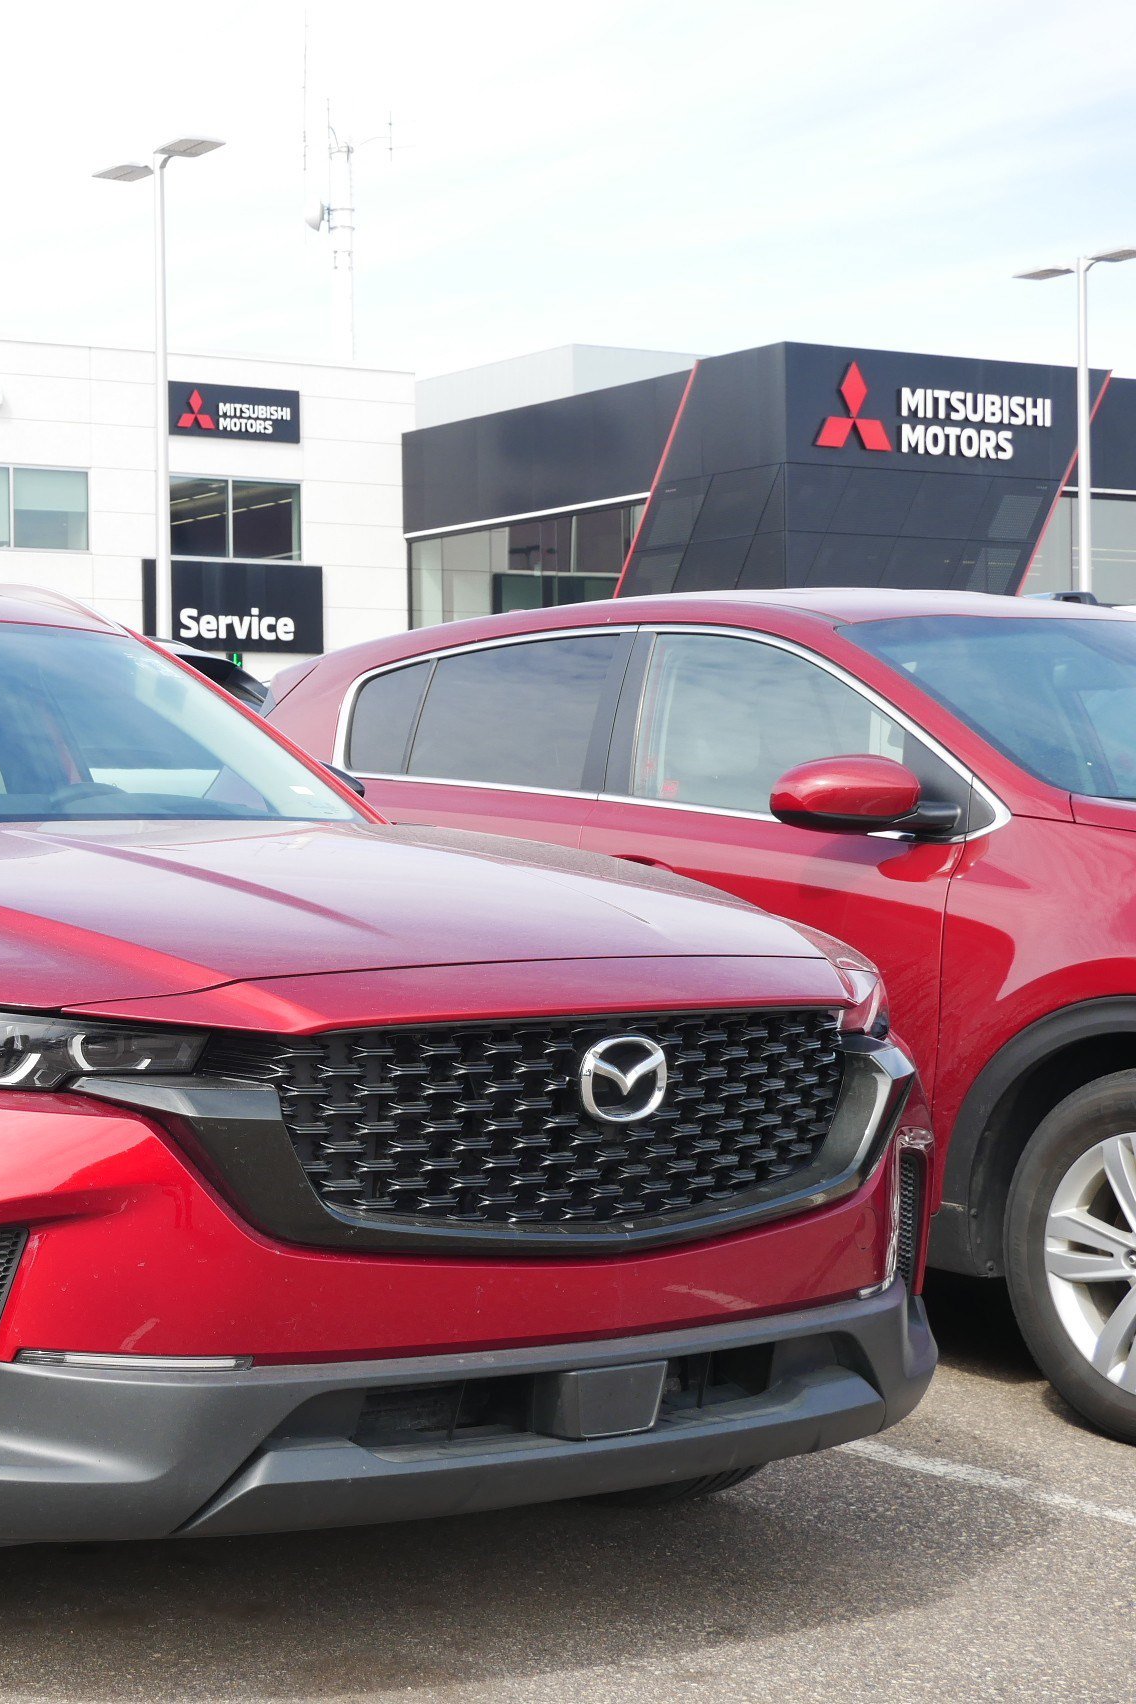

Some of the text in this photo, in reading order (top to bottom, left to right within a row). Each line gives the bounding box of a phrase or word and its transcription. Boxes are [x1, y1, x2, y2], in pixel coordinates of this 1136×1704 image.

[218, 402, 291, 420] MITSUBISHI
[899, 386, 1052, 427] MITSUBISHI
[218, 418, 273, 434] MOTORS
[899, 423, 1014, 460] MOTORS
[179, 607, 295, 641] Service
